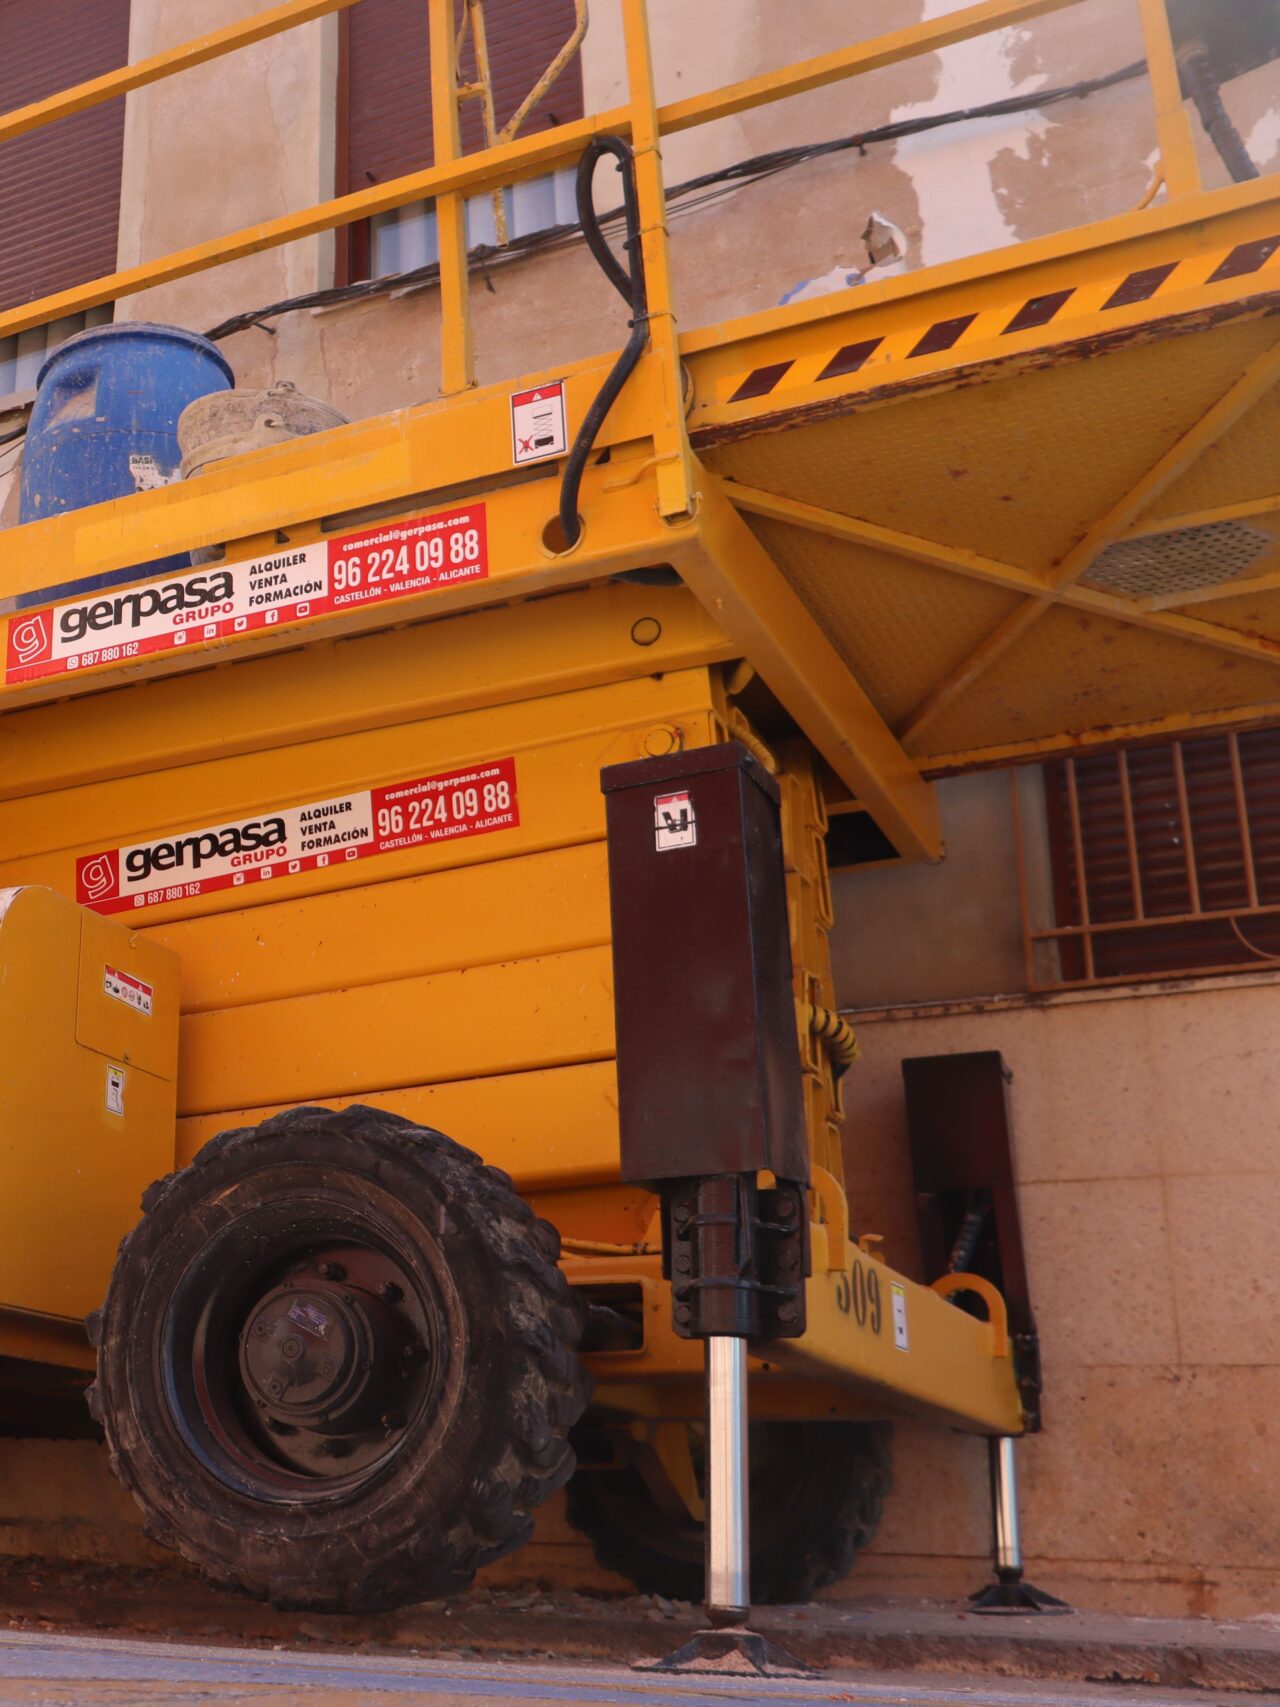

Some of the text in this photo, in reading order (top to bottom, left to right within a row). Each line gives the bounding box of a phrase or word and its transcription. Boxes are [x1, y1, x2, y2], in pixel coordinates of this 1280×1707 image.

[342, 515, 469, 551] comercial@gerpasa.com
[249, 553, 306, 576] ALQUILER
[333, 529, 479, 590] 96 224 09 88
[249, 573, 288, 591] VENTA
[249, 580, 323, 607] FORMACIÓN
[334, 586, 381, 605] CASTELLÓN
[389, 576, 430, 593] VALENCIA
[439, 564, 481, 581] ALICANTE
[60, 571, 235, 644] gerpasa
[172, 601, 234, 625] GRUPO
[81, 642, 139, 666] 687 880 162
[385, 768, 500, 801] comercial@gerpasa.com
[300, 801, 352, 822] ALQUILER
[377, 780, 510, 837] 96 224 09 88
[300, 820, 336, 837] VENTA
[301, 827, 369, 851] FORMACIÓN
[379, 833, 423, 850] CASTELLÓN
[430, 823, 467, 839] VALENCIA
[475, 813, 513, 829] ALICANTE
[125, 817, 287, 882] gerpasa
[230, 845, 287, 867] GRUPO
[147, 882, 200, 904] 687 880 162
